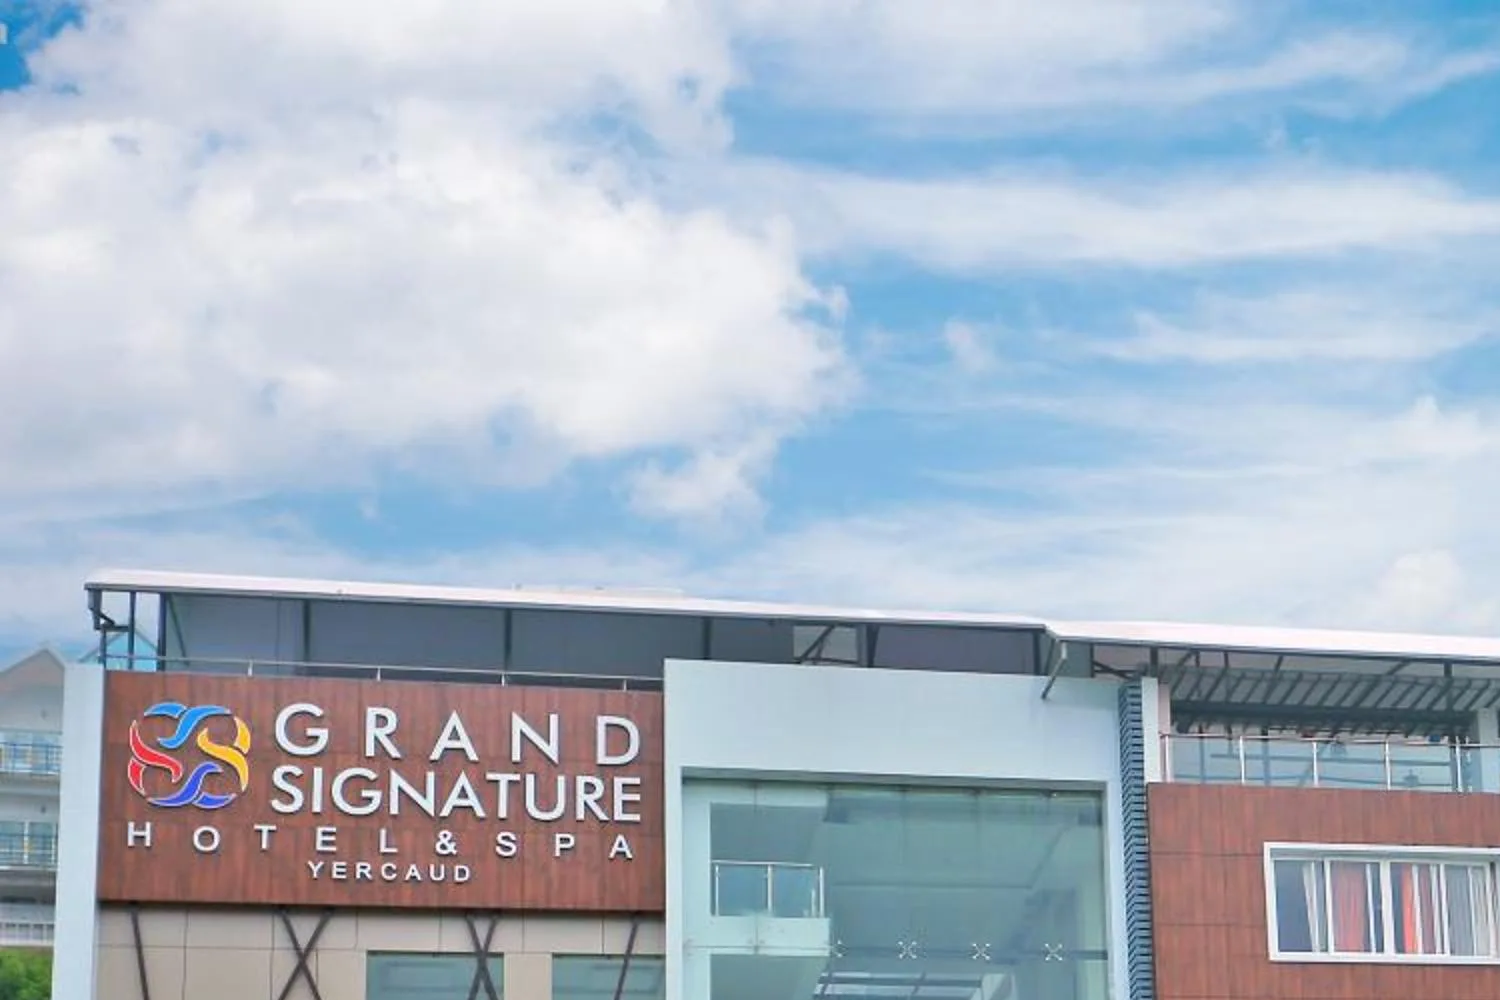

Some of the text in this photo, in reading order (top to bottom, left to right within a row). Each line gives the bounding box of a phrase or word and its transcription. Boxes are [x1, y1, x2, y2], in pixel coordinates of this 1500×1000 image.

[274, 702, 642, 766] GRAND
[270, 764, 642, 823] SIGNATURE
[127, 821, 634, 860] HOTEL & SPA
[307, 860, 471, 883] YERCAUD
